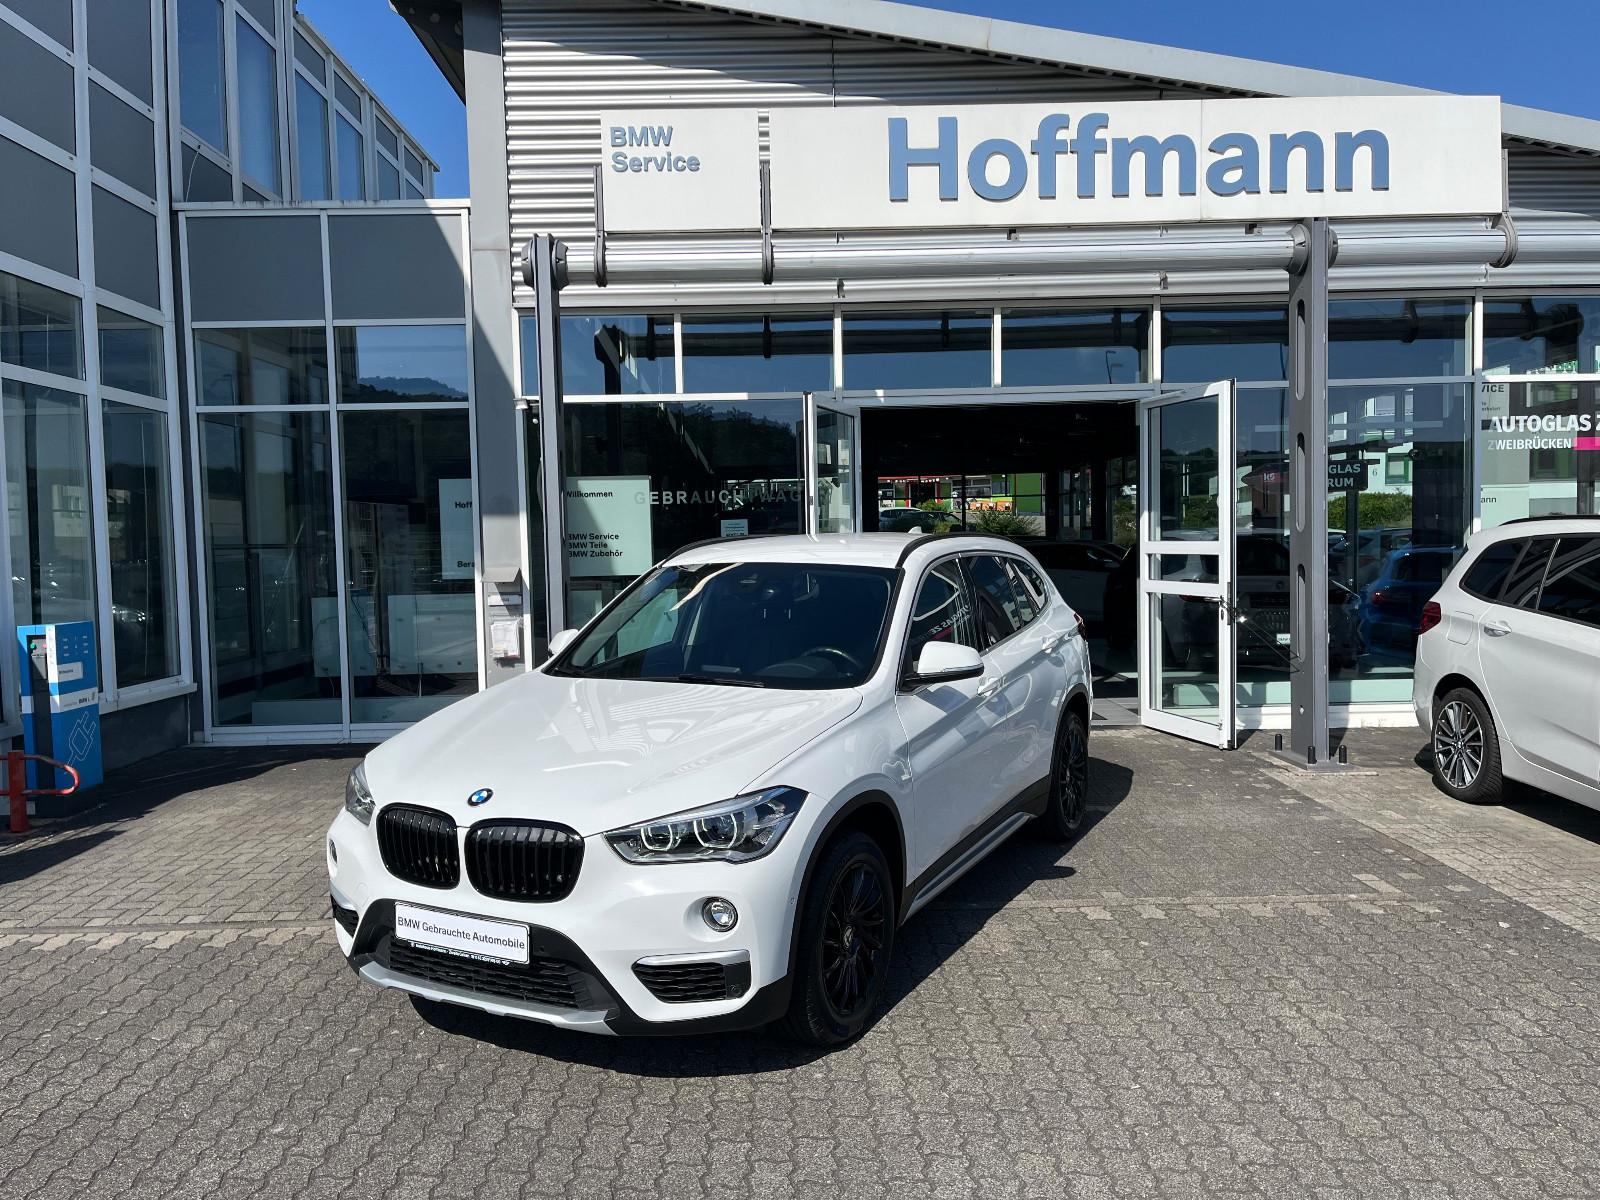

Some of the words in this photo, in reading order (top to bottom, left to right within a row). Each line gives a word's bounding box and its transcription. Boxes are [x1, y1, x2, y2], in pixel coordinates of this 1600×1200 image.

[610, 126, 673, 147] BMW
[611, 151, 700, 172] Service
[888, 112, 1390, 202] Hoffmann
[1488, 413, 1592, 433] AUTOGLAS
[1487, 435, 1572, 450] ZWEIBRÜCKEN
[589, 541, 608, 549] Teile
[589, 549, 624, 558] Zubehör
[397, 915, 420, 930] BMW
[422, 921, 471, 941] Gebrauchte
[472, 930, 525, 949] Automobile
